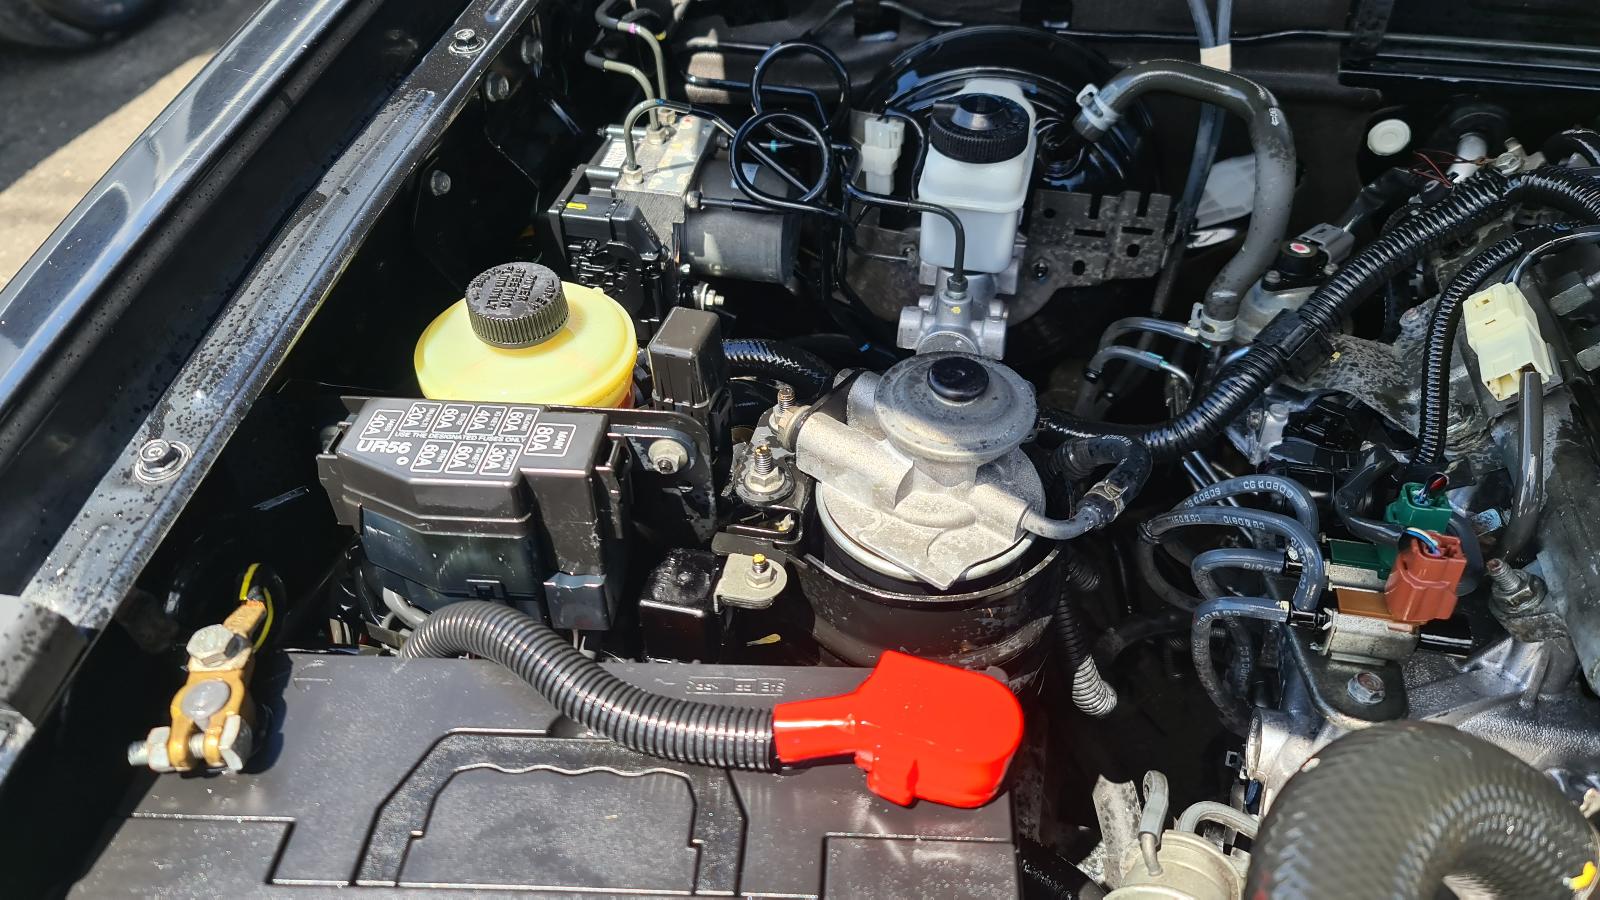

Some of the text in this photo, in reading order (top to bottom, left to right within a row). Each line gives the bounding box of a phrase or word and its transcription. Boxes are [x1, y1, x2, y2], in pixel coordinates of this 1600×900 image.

[499, 268, 527, 309] STEERING
[364, 414, 388, 435] 40A
[403, 406, 427, 428] 20A
[436, 408, 460, 429] 60A
[469, 409, 491, 431] 40A
[502, 411, 525, 433] 60A
[356, 440, 413, 454] UR56
[428, 433, 477, 441] DESIGNATED
[478, 435, 505, 443] FUSES
[504, 436, 527, 444] ONLY
[529, 426, 555, 452] 80A
[552, 431, 569, 450] MAIN
[415, 444, 440, 467] 60A
[448, 445, 474, 469] 60A
[484, 447, 508, 471] 30A
